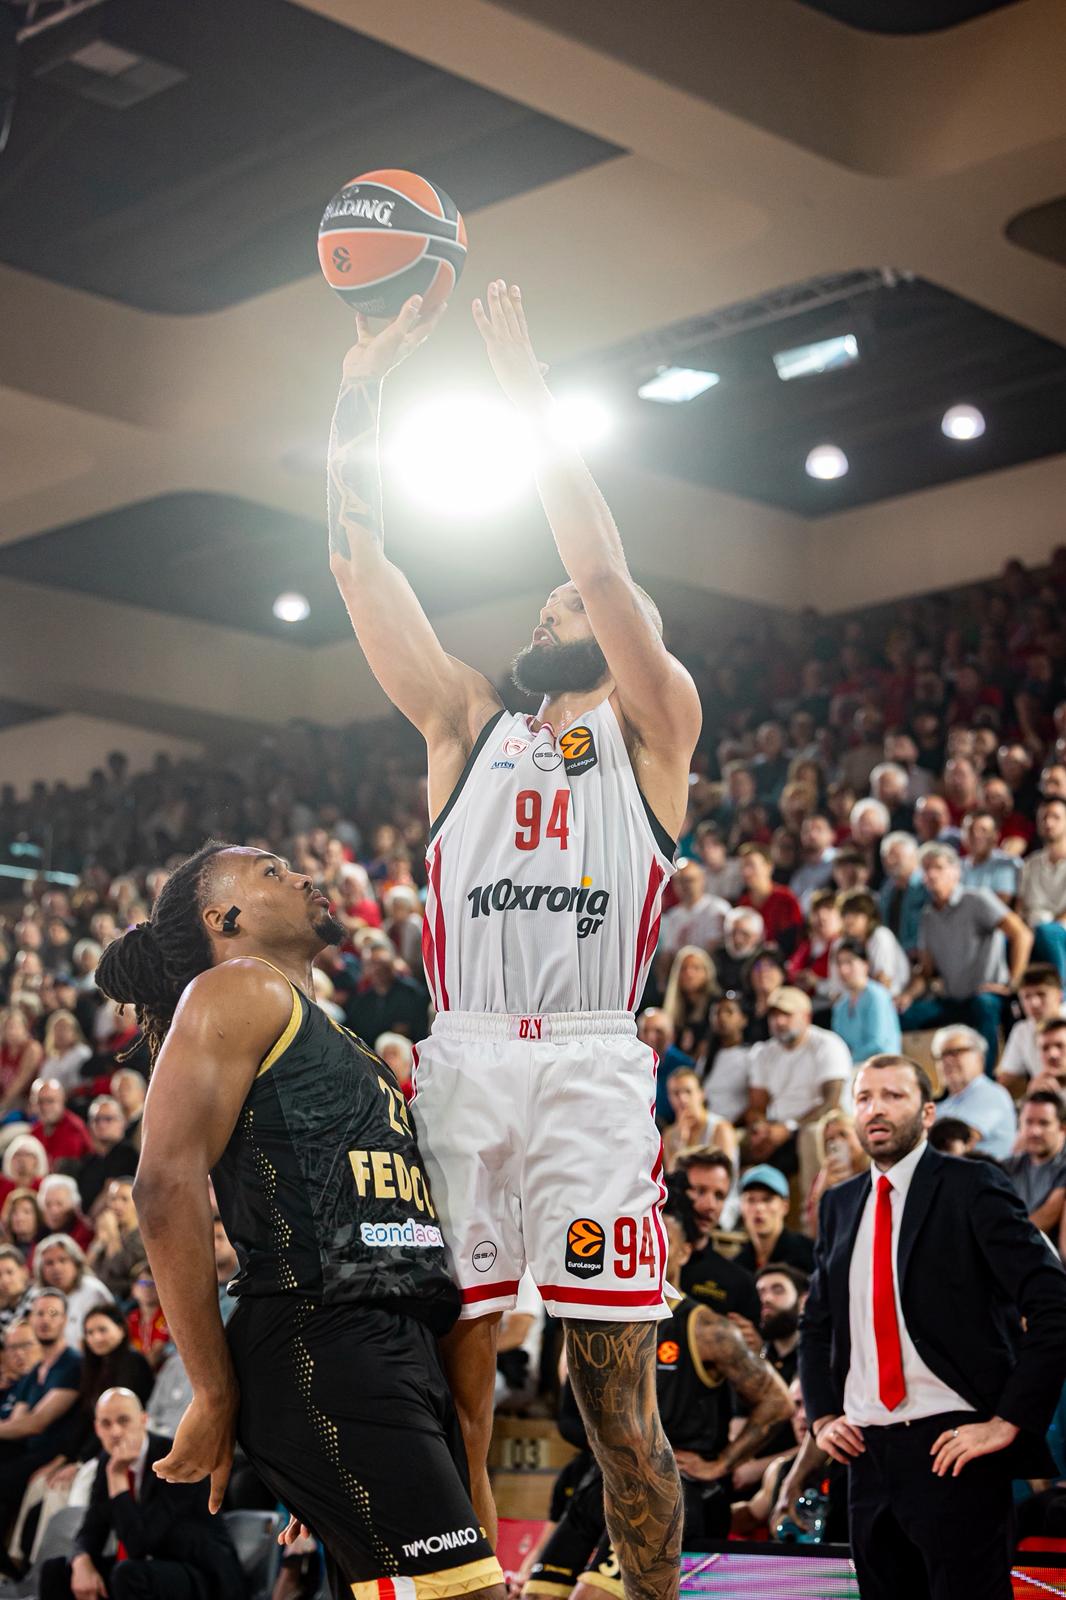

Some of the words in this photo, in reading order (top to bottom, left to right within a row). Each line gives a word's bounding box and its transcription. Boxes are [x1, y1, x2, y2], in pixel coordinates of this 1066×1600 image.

[514, 789, 571, 851] 94
[518, 1019, 542, 1040] OLY
[567, 1261, 602, 1271] EuroLeague
[613, 1216, 656, 1280] 94
